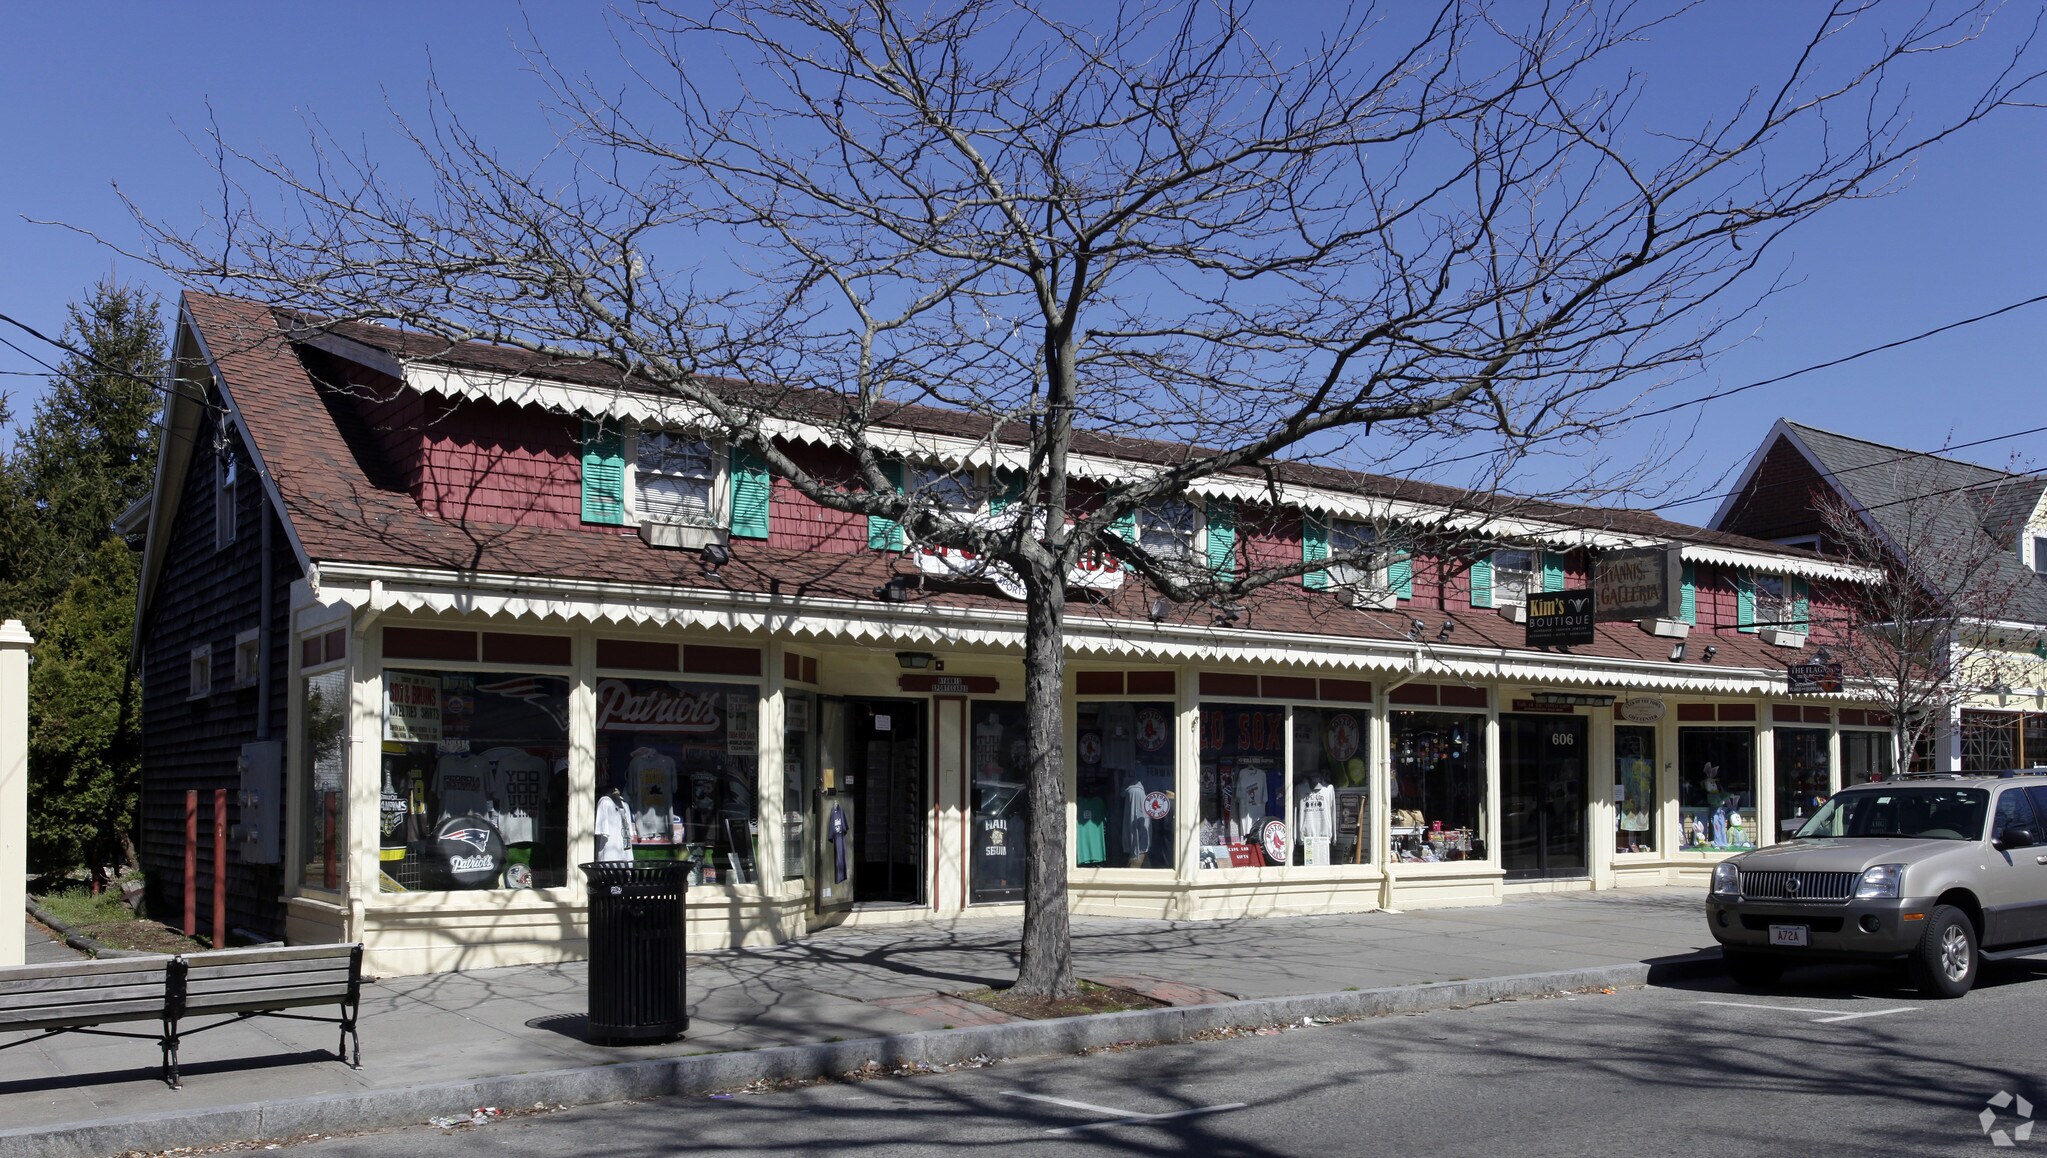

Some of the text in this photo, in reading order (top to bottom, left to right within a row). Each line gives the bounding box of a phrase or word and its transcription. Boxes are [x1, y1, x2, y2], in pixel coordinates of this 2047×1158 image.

[998, 576, 1027, 596] SPORTS
[1601, 584, 1660, 607] GALLERIA
[1530, 598, 1565, 617] Kim's
[1529, 615, 1590, 628] BOUTIQUE
[597, 679, 721, 731] Patriots
[1138, 711, 1165, 724] BOSTON
[1200, 710, 1281, 751] ED SOX
[1552, 733, 1574, 746] 606
[1146, 793, 1167, 802] BOSTON
[985, 819, 1008, 831] HAIL
[1266, 824, 1286, 839] BOSTON
[450, 855, 494, 873] Patriots
[1777, 930, 1799, 942] A72A
